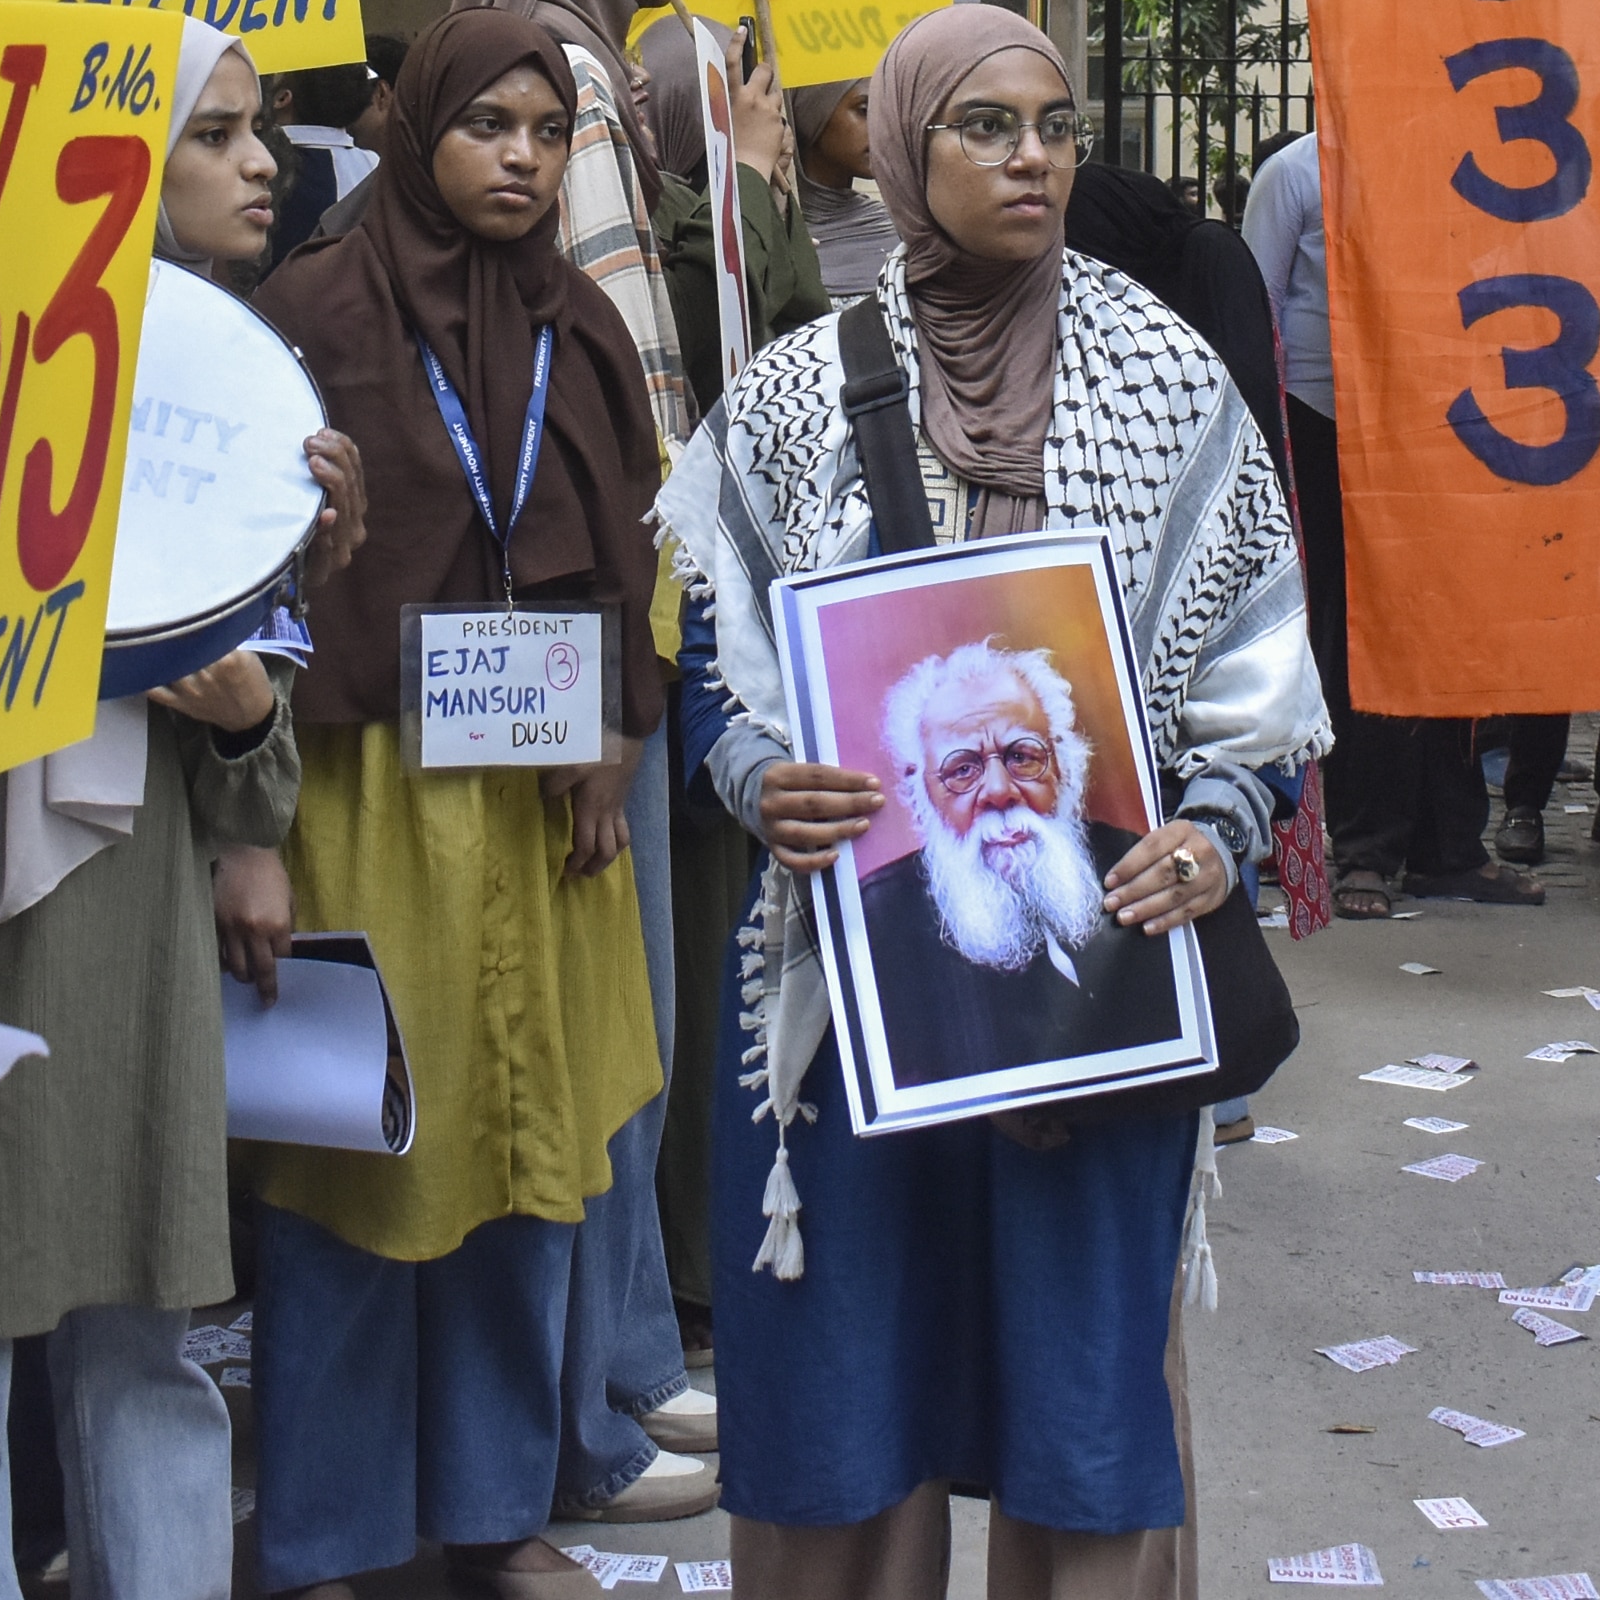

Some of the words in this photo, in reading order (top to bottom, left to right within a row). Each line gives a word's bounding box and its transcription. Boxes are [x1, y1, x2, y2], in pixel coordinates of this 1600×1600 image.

[1444, 35, 1592, 223] 3
[17, 134, 152, 593] 3
[522, 418, 537, 465] MOVEMENT
[463, 619, 573, 638] PRESIDENT
[428, 646, 510, 677] EJAJ
[426, 686, 546, 718] MANSURI
[512, 720, 568, 748] DUSU
